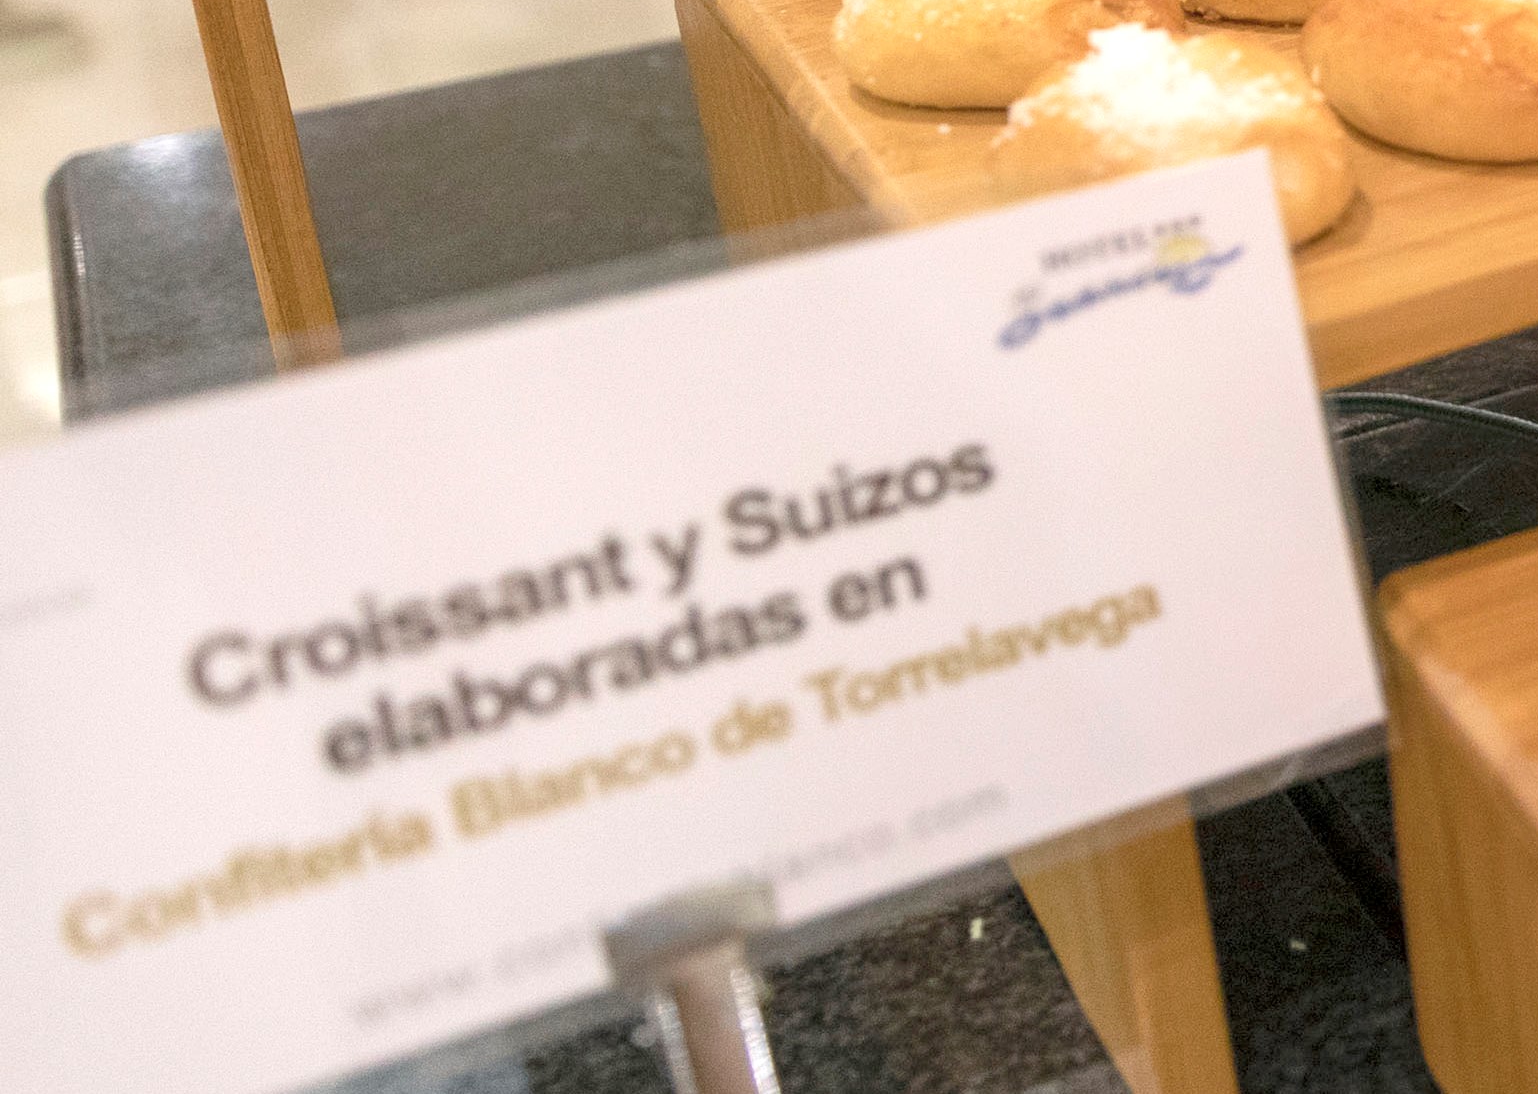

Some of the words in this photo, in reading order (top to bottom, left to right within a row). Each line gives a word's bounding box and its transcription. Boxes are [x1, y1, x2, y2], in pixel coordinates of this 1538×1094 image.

[185, 533, 635, 710] Croissant
[650, 521, 703, 598] y
[720, 440, 995, 558] Suizos
[321, 590, 811, 774] elaboradas
[825, 553, 928, 624] en
[60, 803, 434, 958] Confitería
[448, 723, 699, 842] Blanco
[711, 697, 794, 759] de
[802, 578, 1163, 725] Torrelavega
